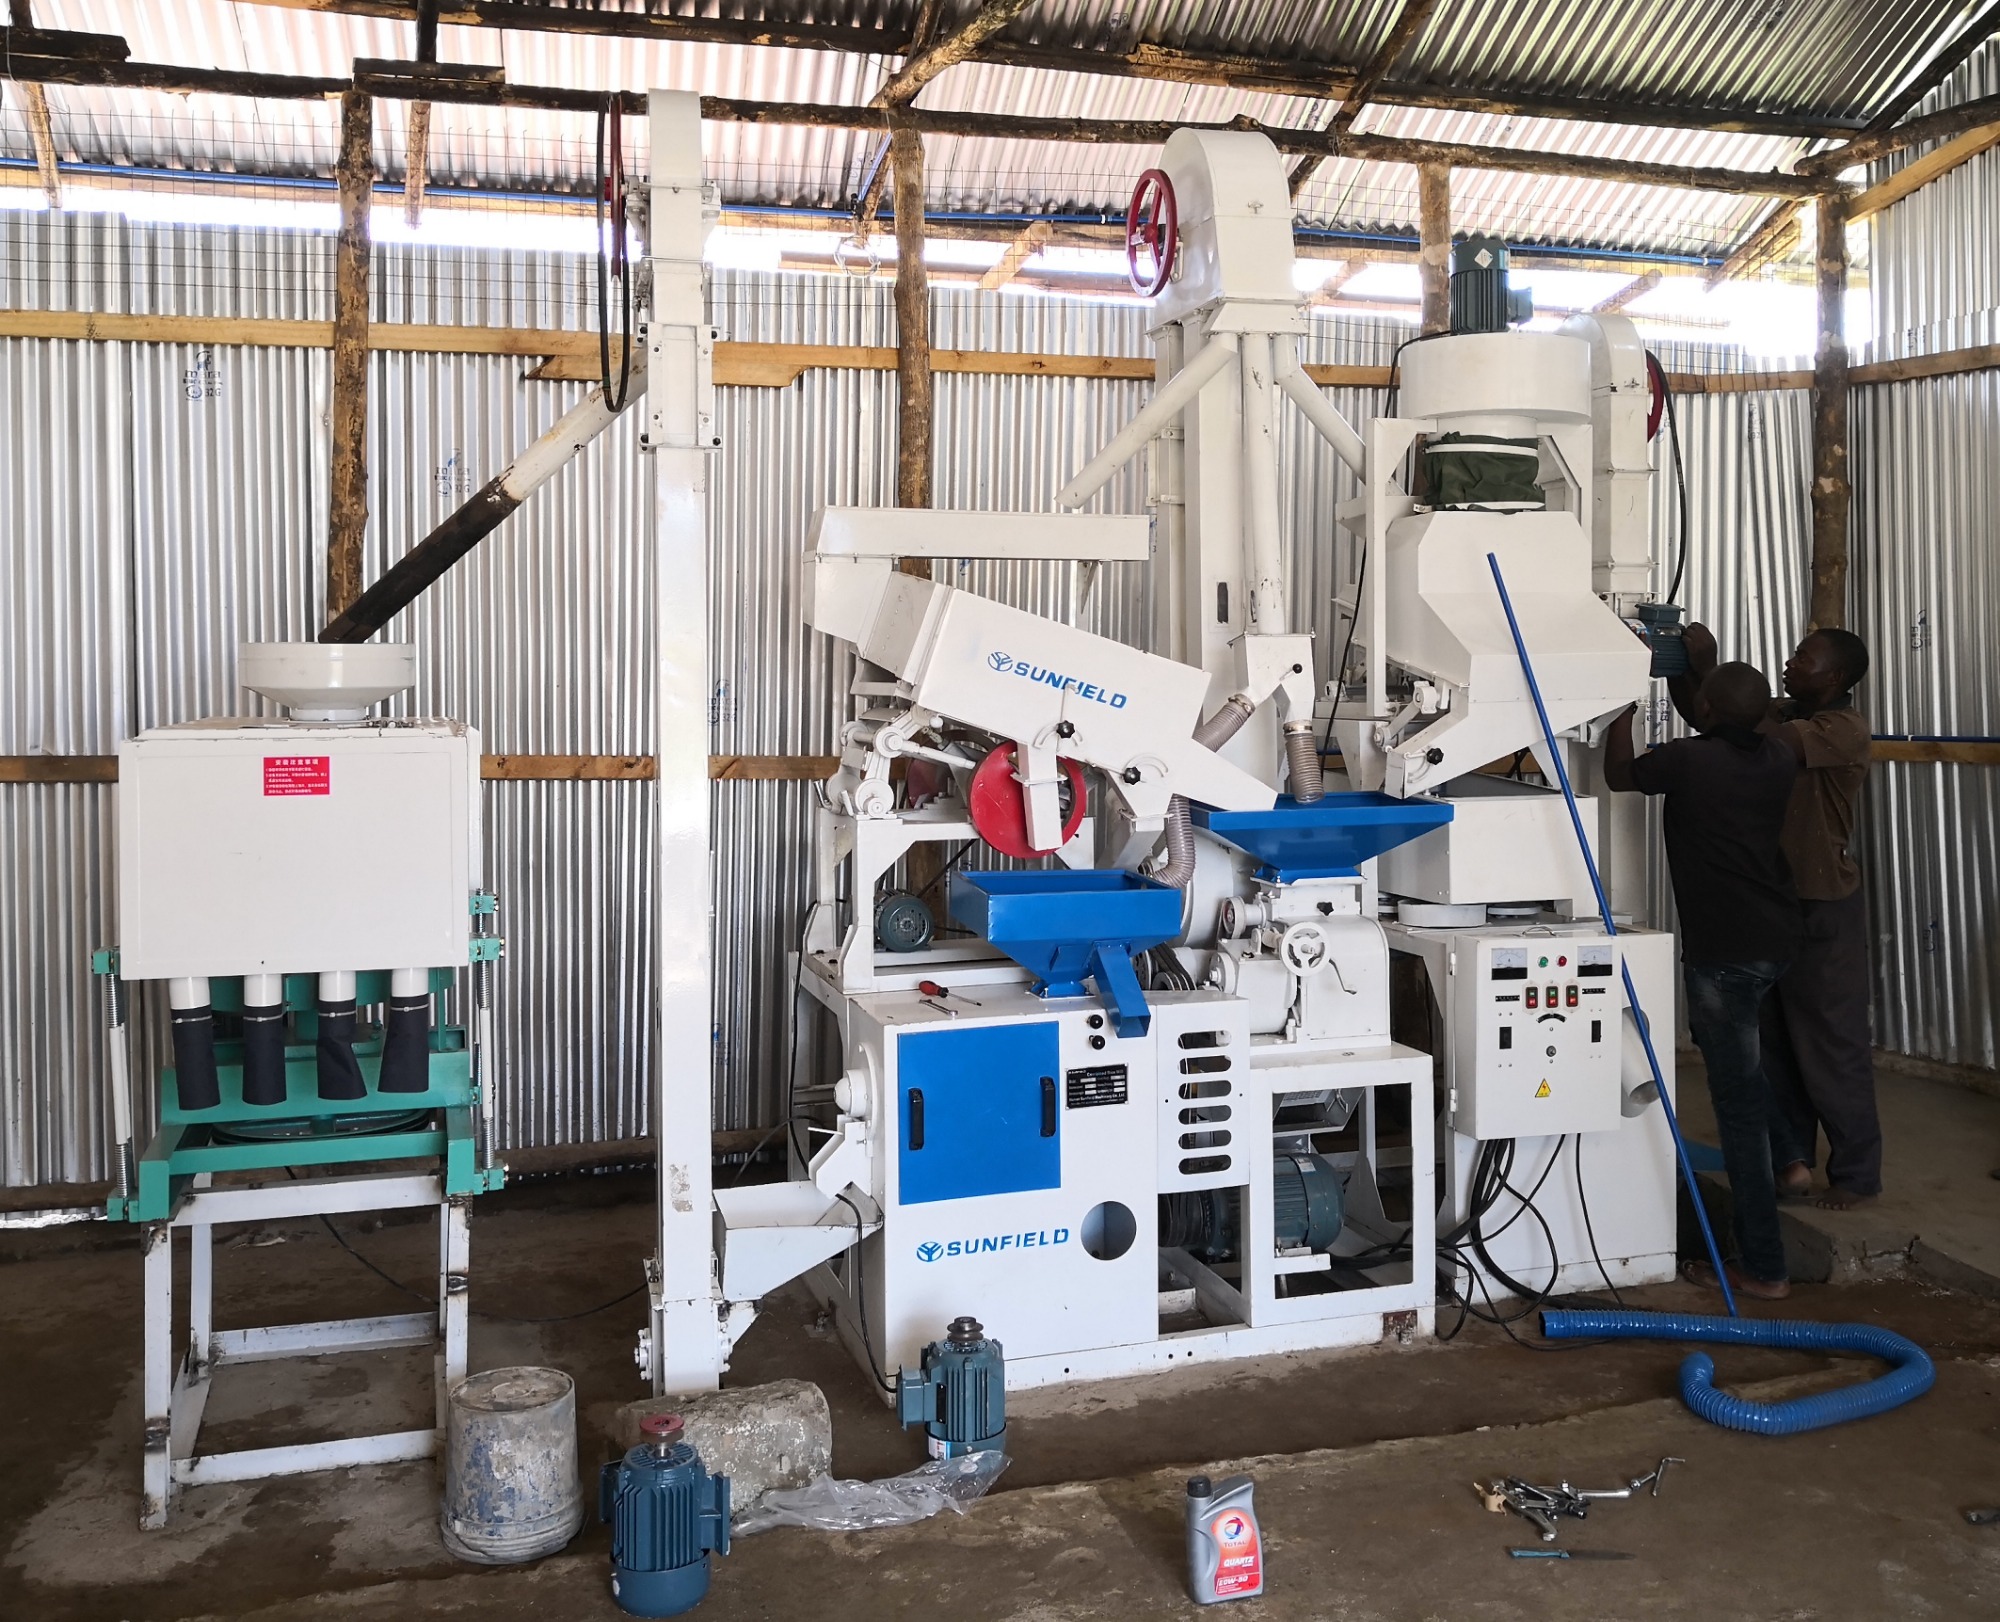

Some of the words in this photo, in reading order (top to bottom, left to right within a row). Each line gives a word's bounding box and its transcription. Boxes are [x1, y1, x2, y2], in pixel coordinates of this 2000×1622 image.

[1014, 661, 1127, 709] SUNFIELD
[947, 1228, 1069, 1257] SUNFIELD
[1224, 1540, 1246, 1548] TOTAL
[1223, 1555, 1255, 1568] QUARTZ
